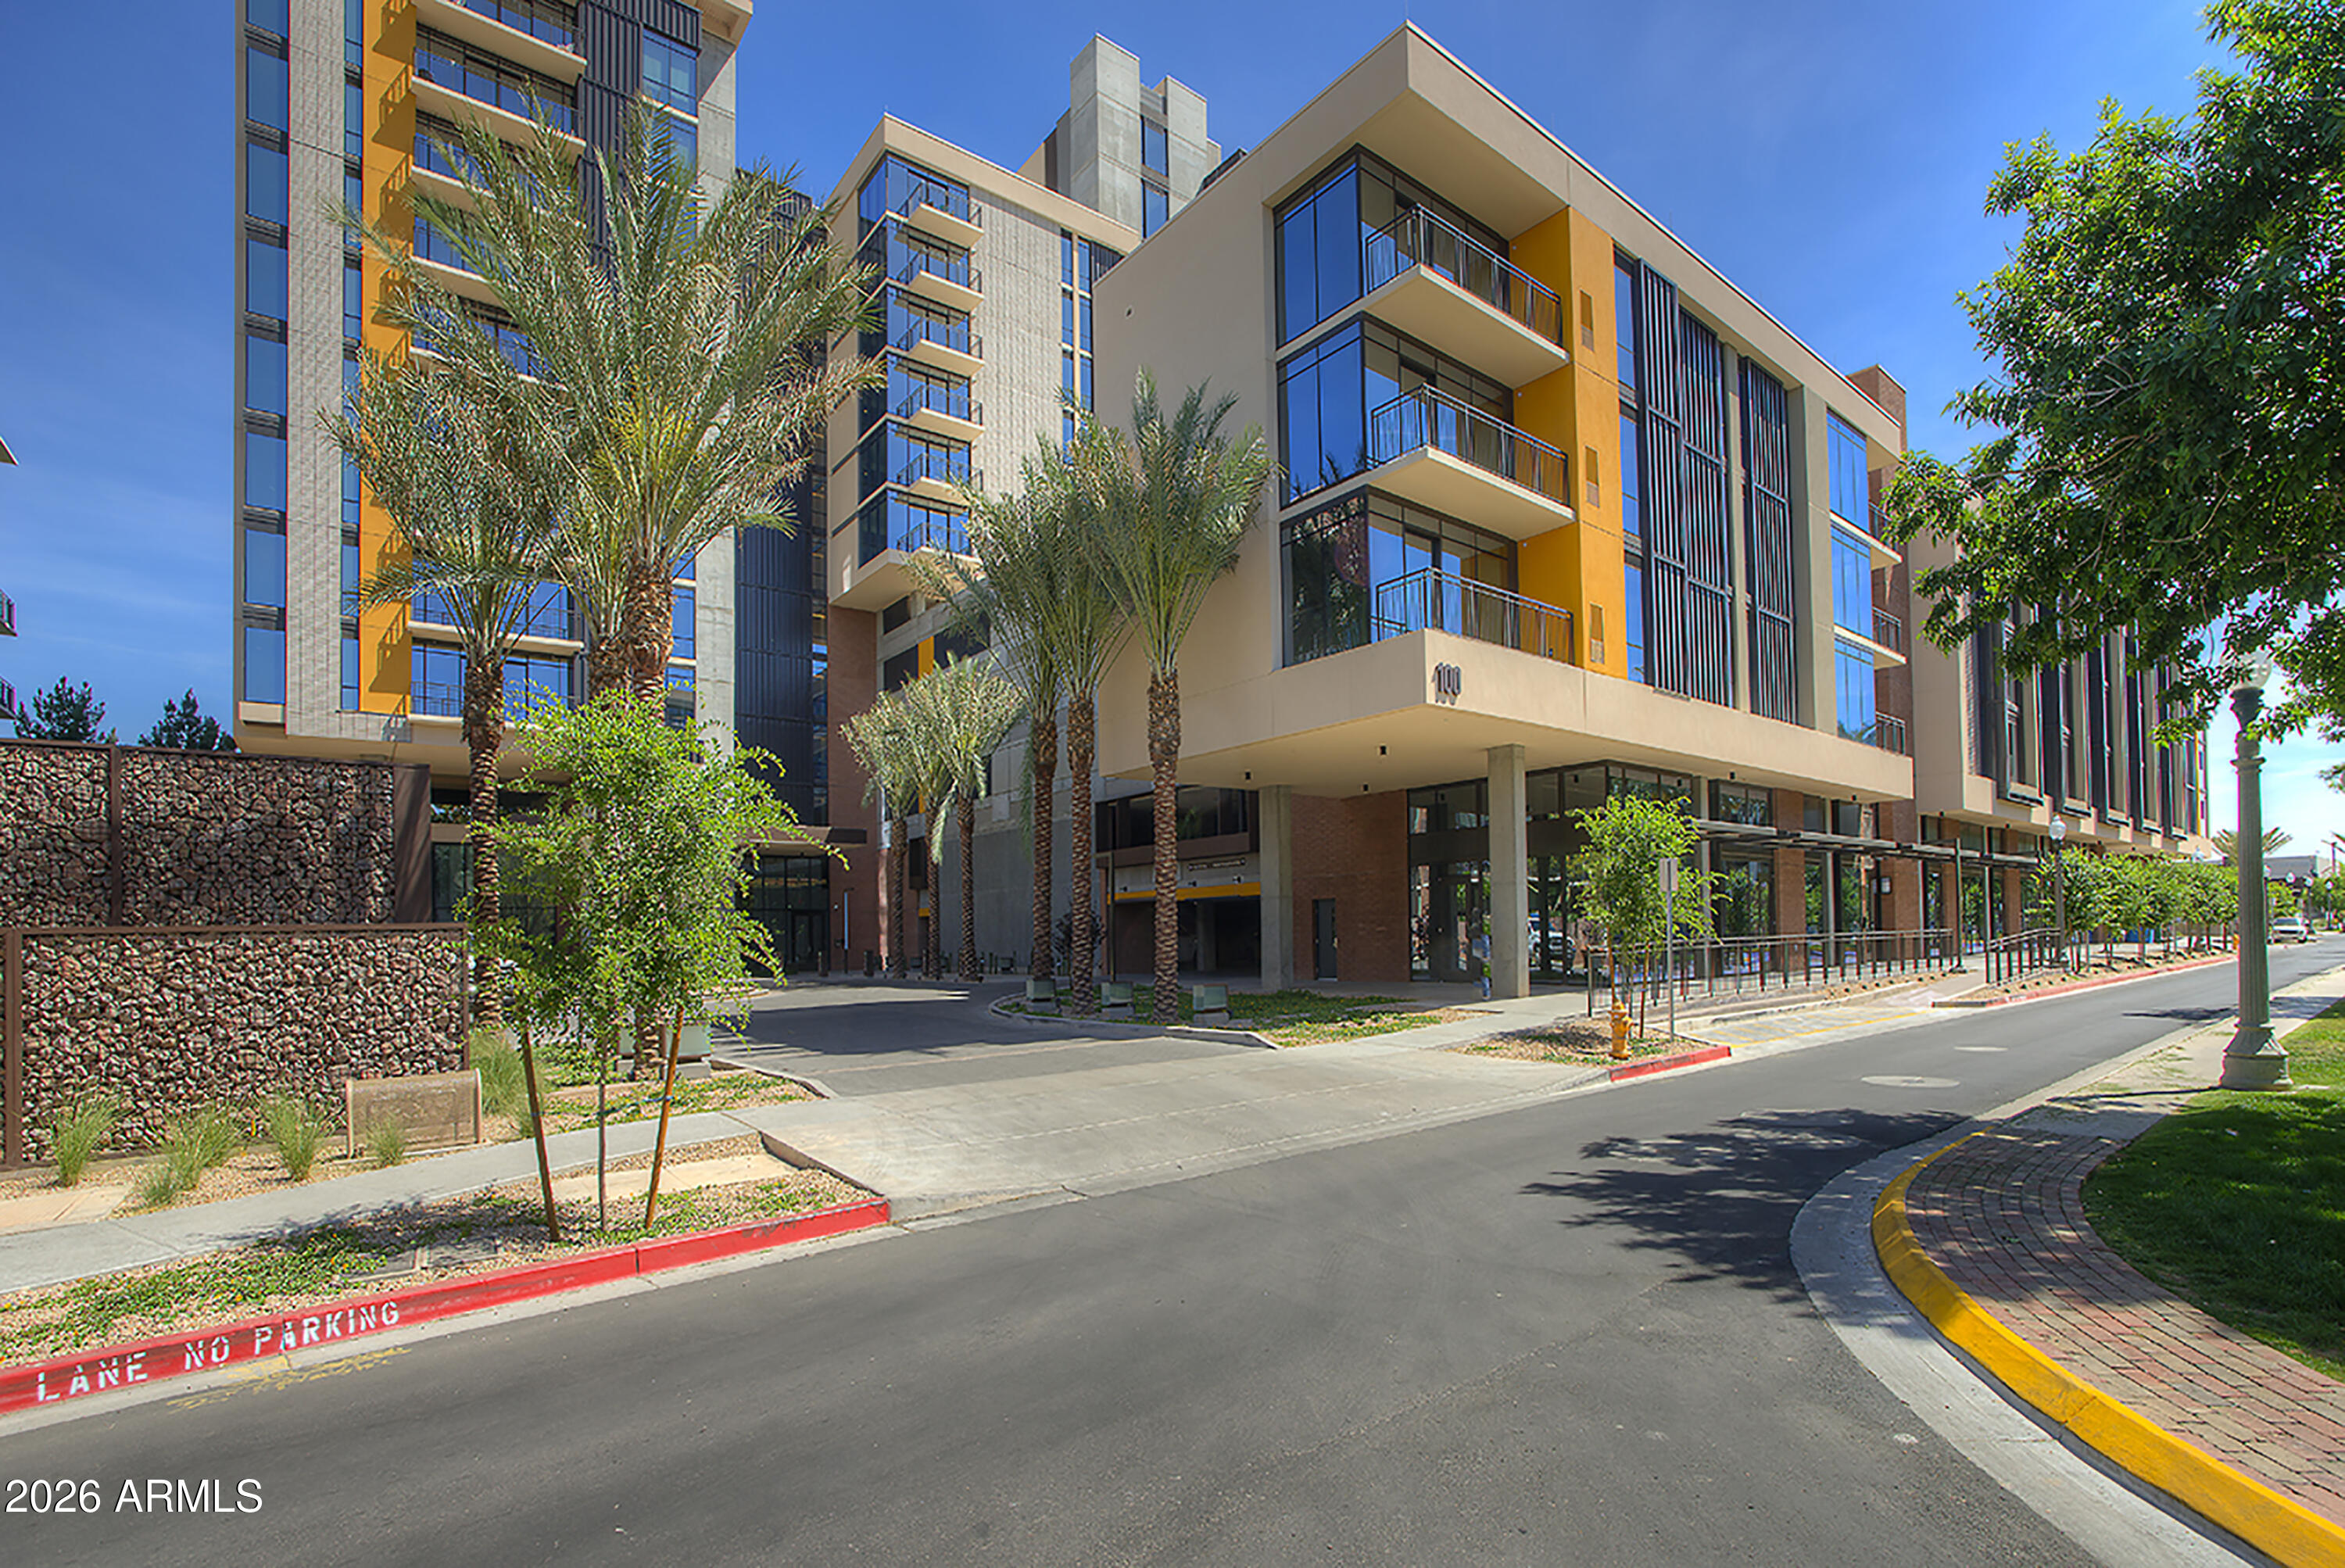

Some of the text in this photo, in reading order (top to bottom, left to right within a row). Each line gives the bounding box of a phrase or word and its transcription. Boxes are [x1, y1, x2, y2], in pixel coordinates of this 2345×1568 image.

[1434, 662, 1462, 697] 100
[38, 1301, 399, 1402] LANE NO PARKING
